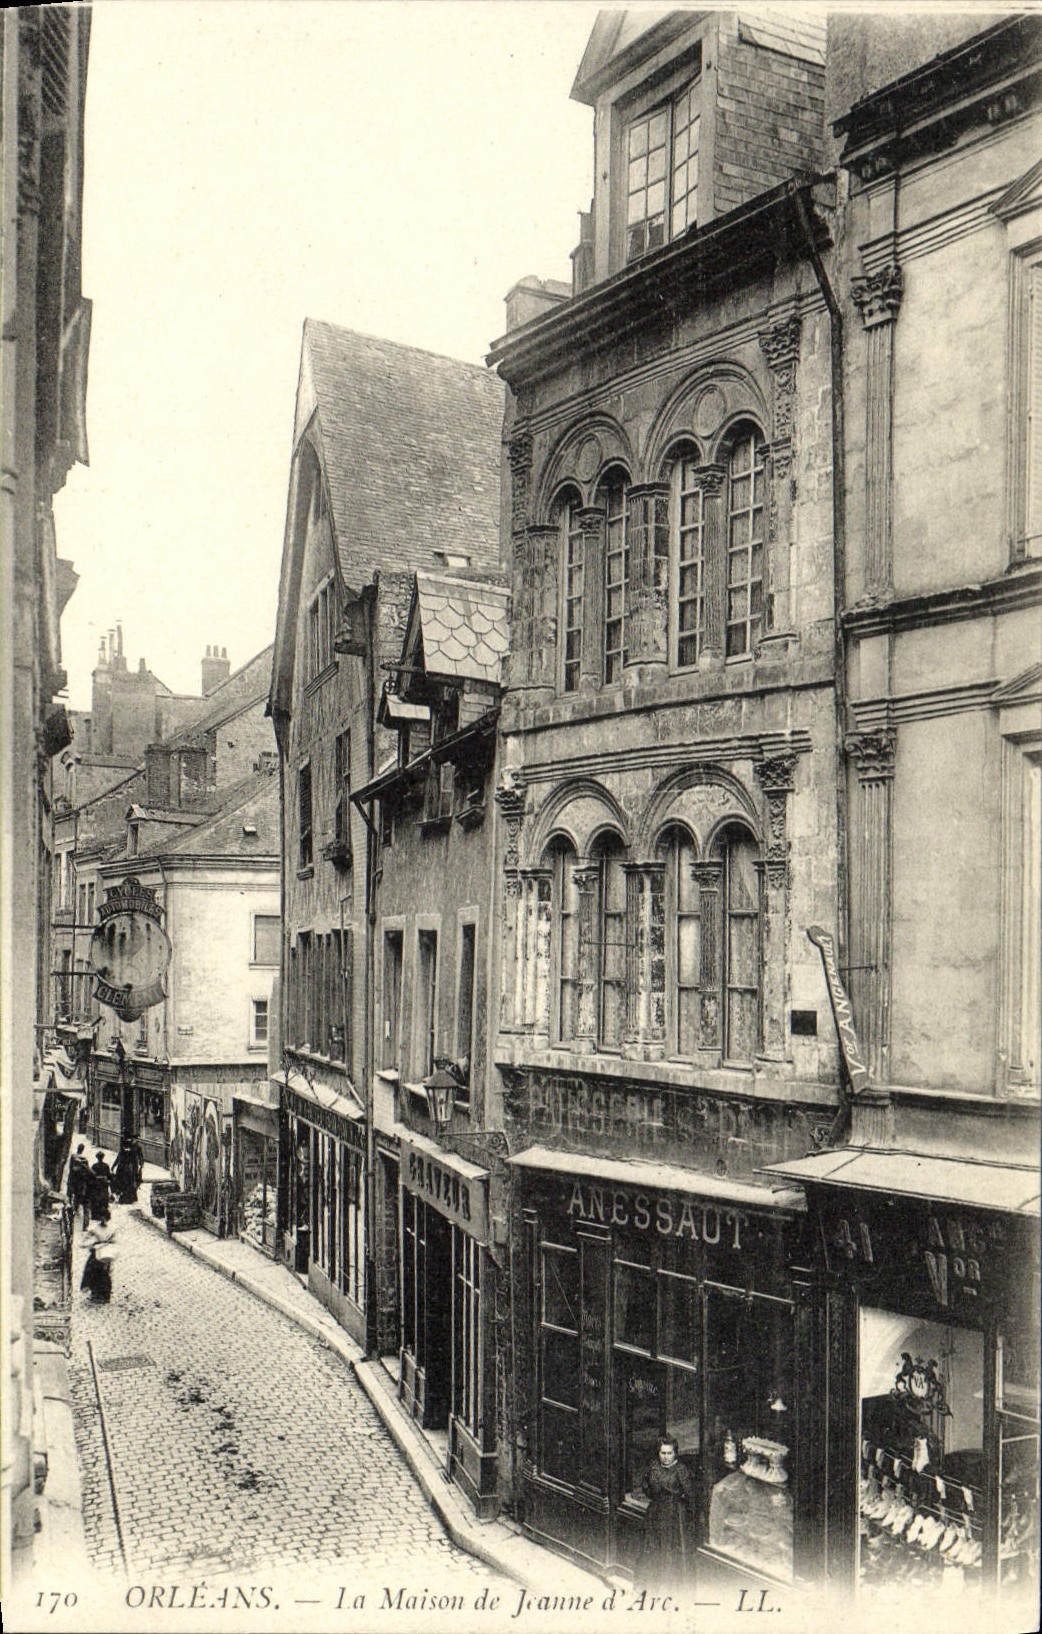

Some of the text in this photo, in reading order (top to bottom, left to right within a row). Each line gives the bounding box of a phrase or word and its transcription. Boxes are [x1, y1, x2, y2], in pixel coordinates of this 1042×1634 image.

[100, 899, 163, 917] AUTOMOBILES
[819, 935, 857, 1039] ANGENAULT
[408, 1151, 471, 1221] GRAVEUR
[566, 1185, 750, 1250] ANESSAUT
